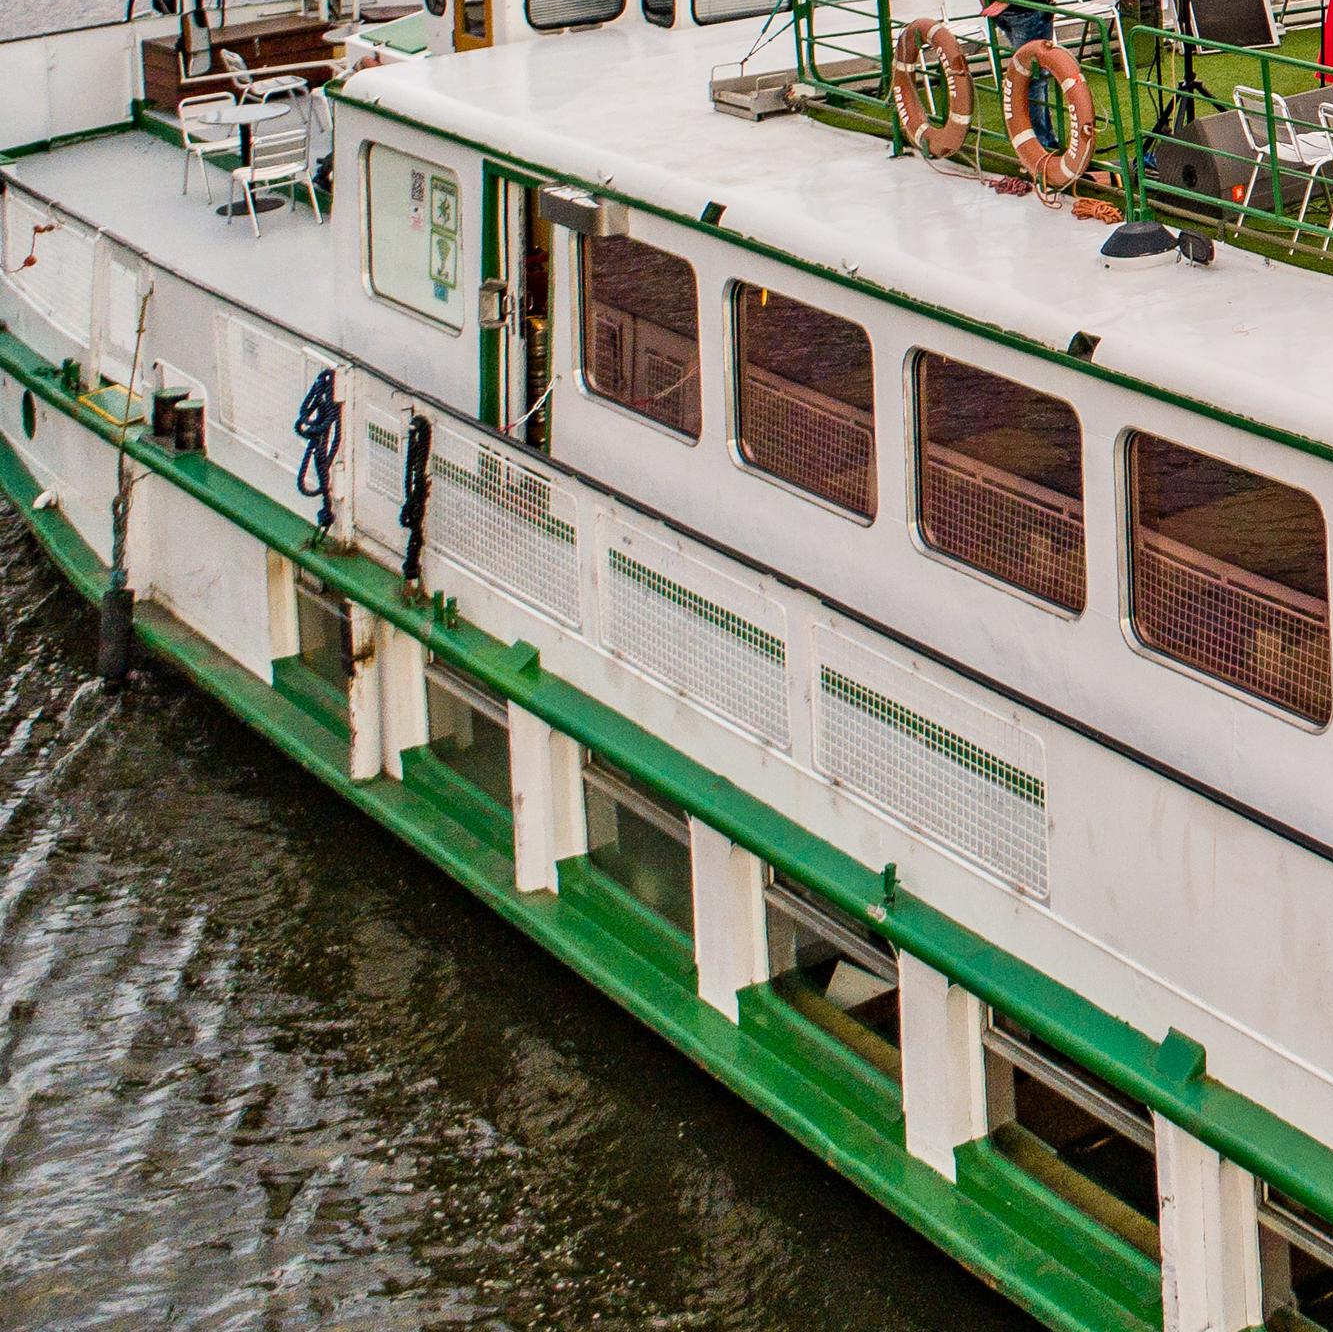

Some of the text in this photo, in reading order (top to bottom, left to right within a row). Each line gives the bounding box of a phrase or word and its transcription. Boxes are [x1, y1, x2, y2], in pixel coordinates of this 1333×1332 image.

[893, 85, 909, 125] PRAHA
[1004, 79, 1014, 120] PRAHA
[1068, 103, 1080, 160] CZECHIE
